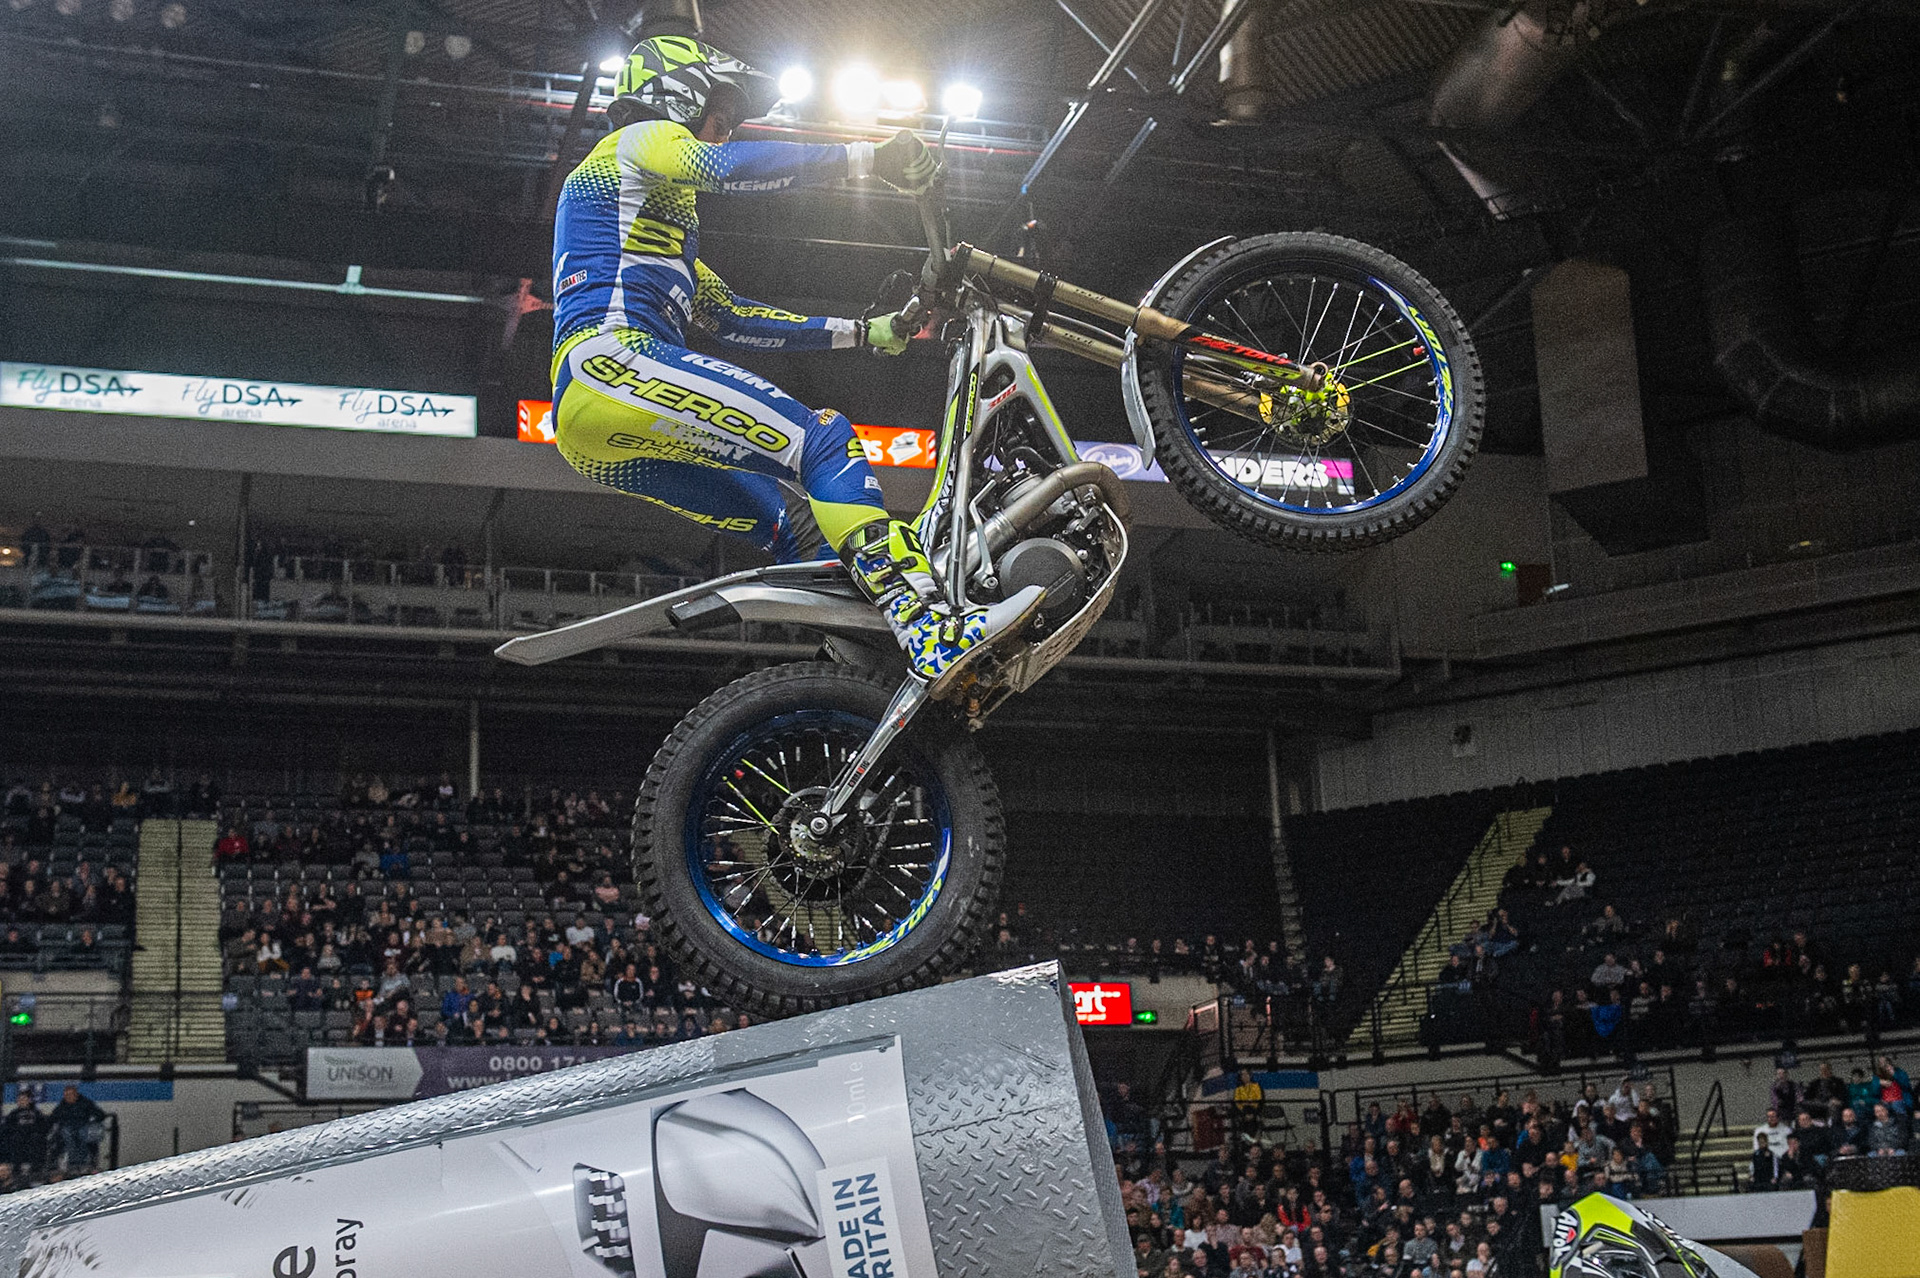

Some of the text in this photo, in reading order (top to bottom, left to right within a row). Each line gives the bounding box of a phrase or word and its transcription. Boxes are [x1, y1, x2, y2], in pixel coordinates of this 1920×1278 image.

[723, 176, 796, 191] KENNY
[723, 332, 787, 348] KENNY
[1190, 336, 1293, 365] FACTORY
[681, 353, 794, 401] KENNY
[581, 355, 790, 453] SHERCO
[328, 1066, 393, 1081] UNISON
[489, 1056, 543, 1071] 0800
[832, 1178, 856, 1211] IN
